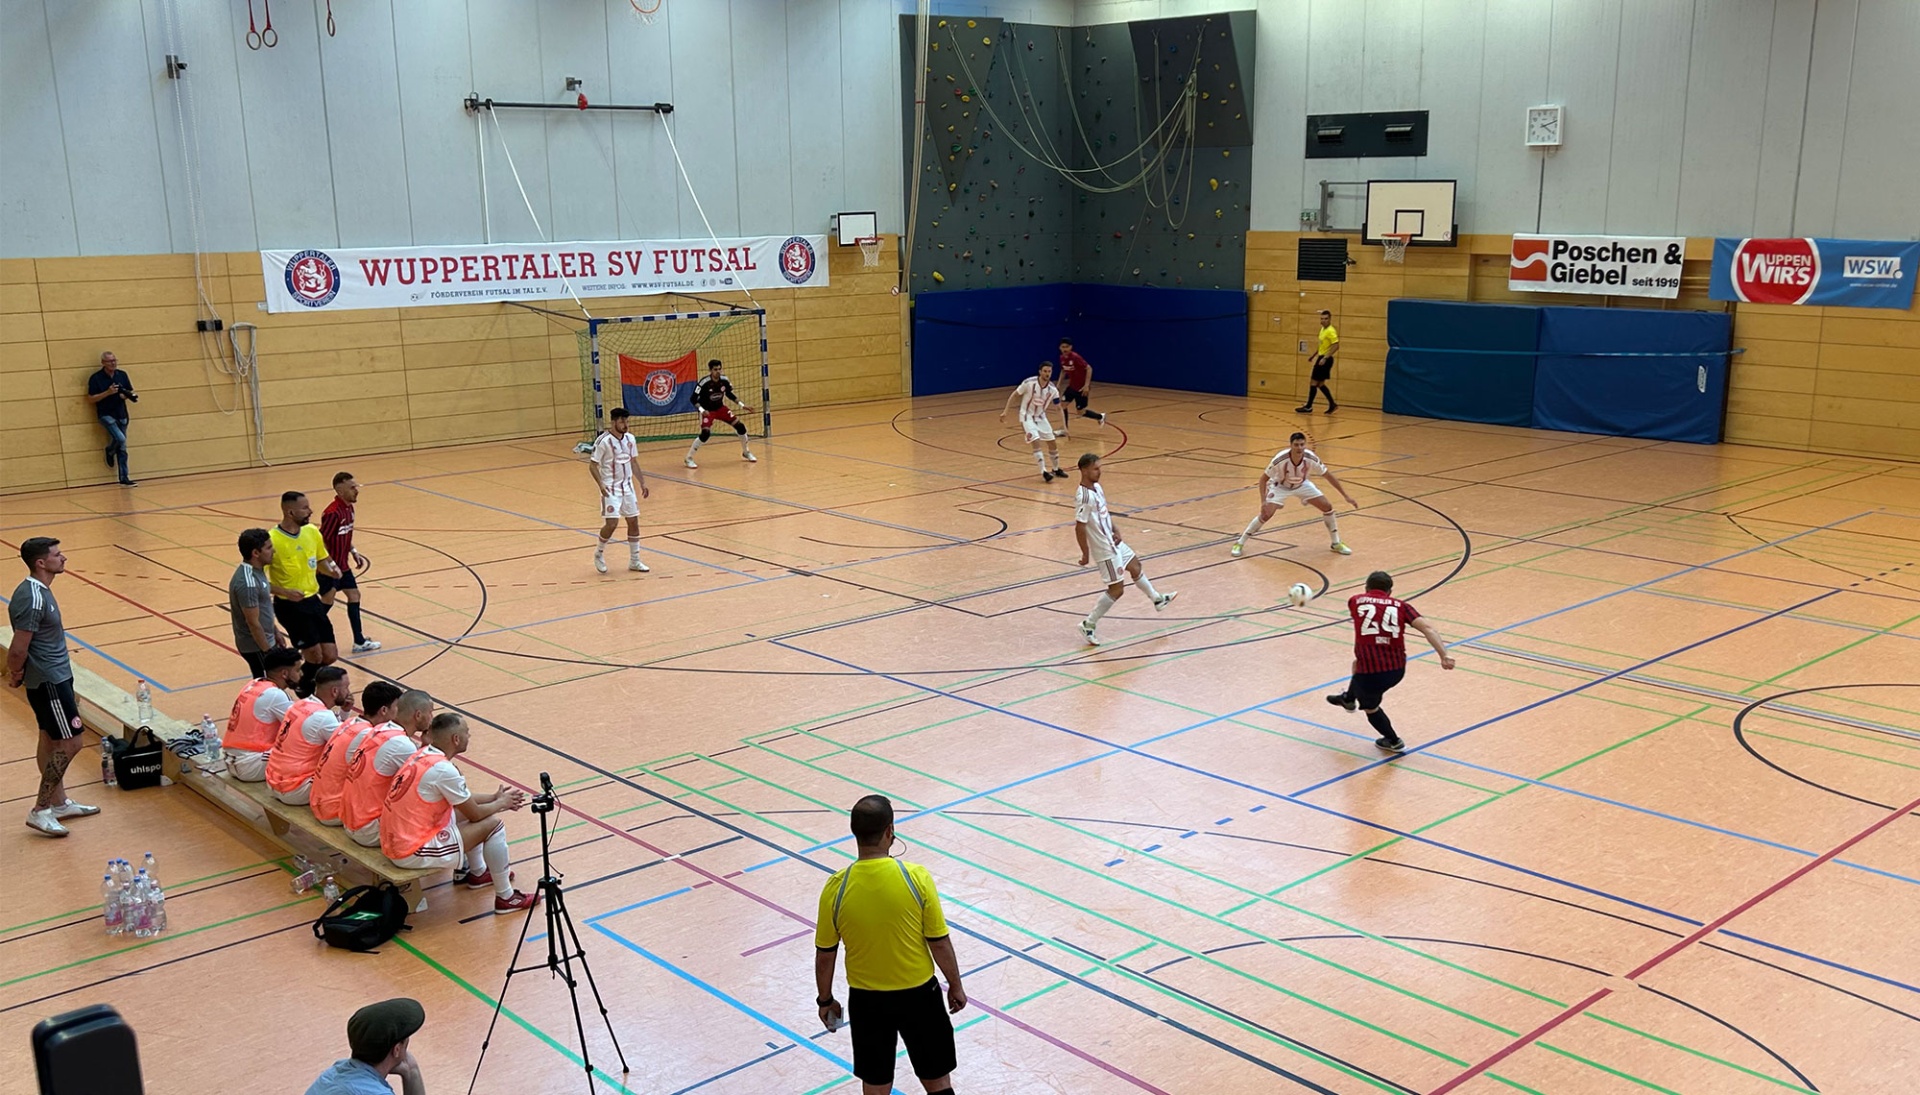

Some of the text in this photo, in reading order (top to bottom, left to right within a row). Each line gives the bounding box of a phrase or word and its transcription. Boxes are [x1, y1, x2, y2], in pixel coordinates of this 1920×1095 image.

[1552, 240, 1682, 265] Poschen &
[359, 247, 757, 287] WUPPERTALER SV FUTSAL
[1550, 262, 1679, 288] Giebel seit 1919
[1742, 260, 1811, 286] WIR'S
[430, 289, 484, 299] FÖRDERVEREIN
[485, 288, 511, 297] FUTSAL
[1357, 604, 1400, 639] 24
